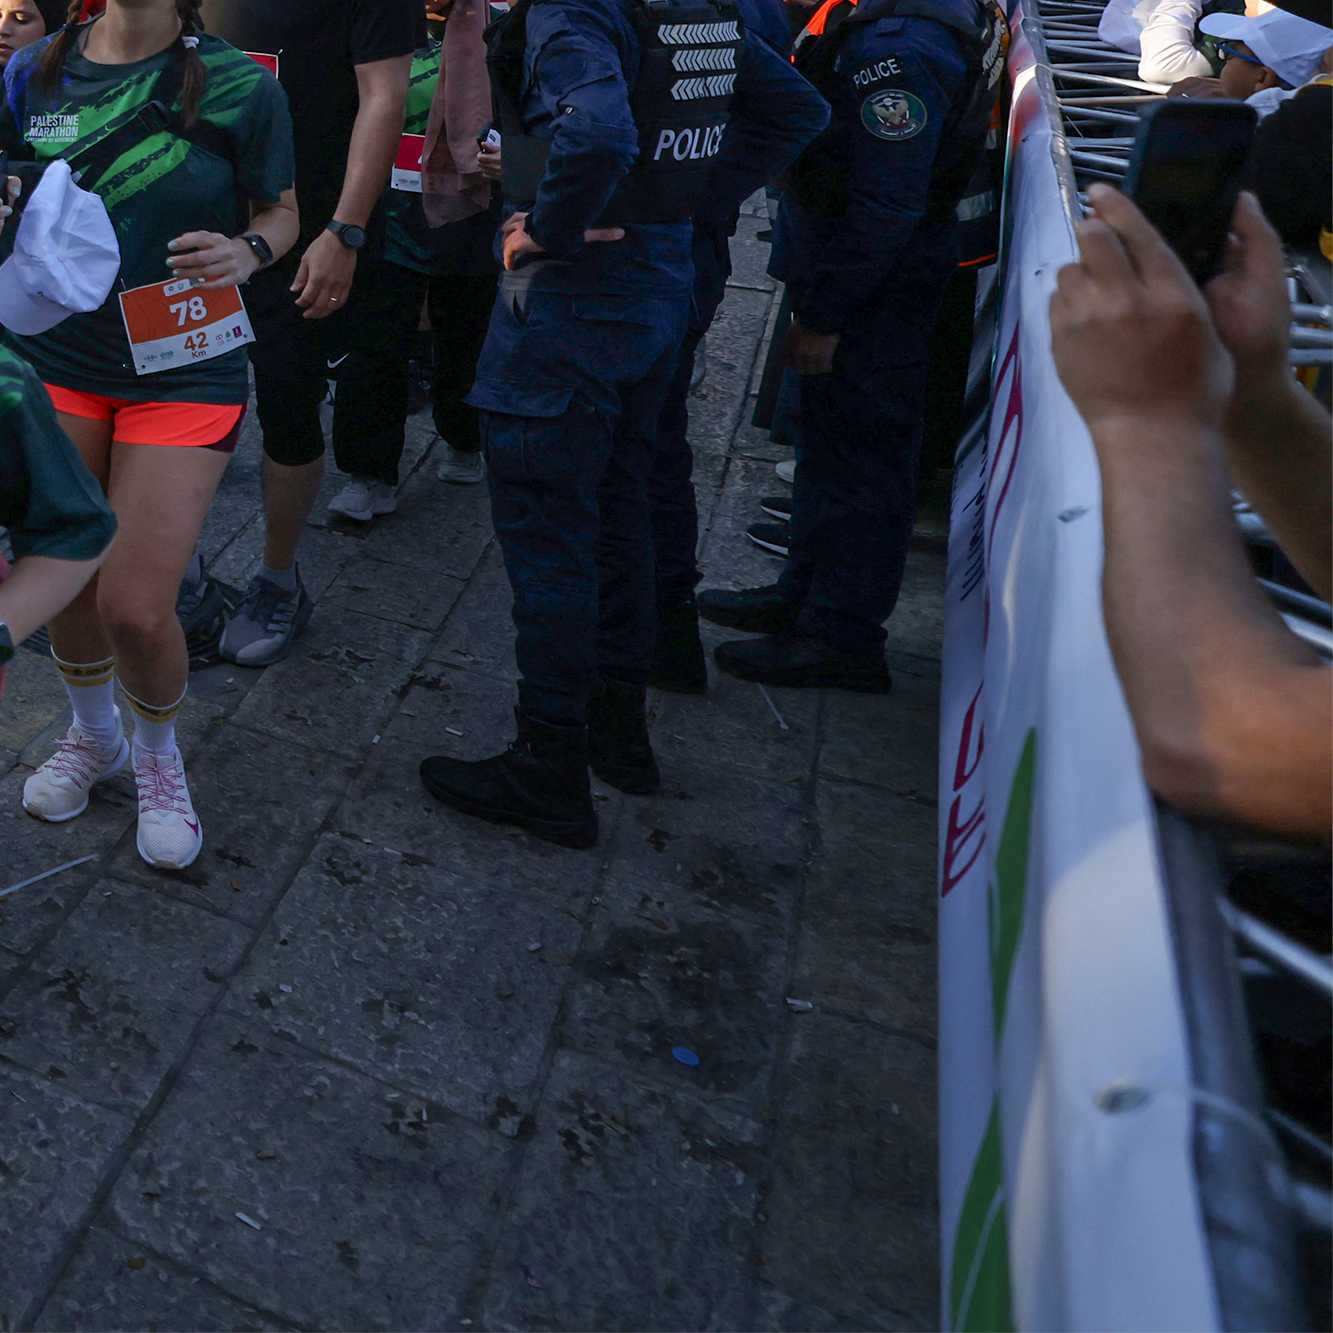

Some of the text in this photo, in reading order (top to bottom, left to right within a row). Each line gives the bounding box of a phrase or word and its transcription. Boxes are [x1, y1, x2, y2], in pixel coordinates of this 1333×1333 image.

[852, 58, 902, 90] POLICE
[30, 114, 80, 126] PALESTINE
[29, 126, 79, 138] MARATHON
[169, 296, 208, 327] 78
[184, 332, 210, 351] 42
[191, 350, 208, 359] Km
